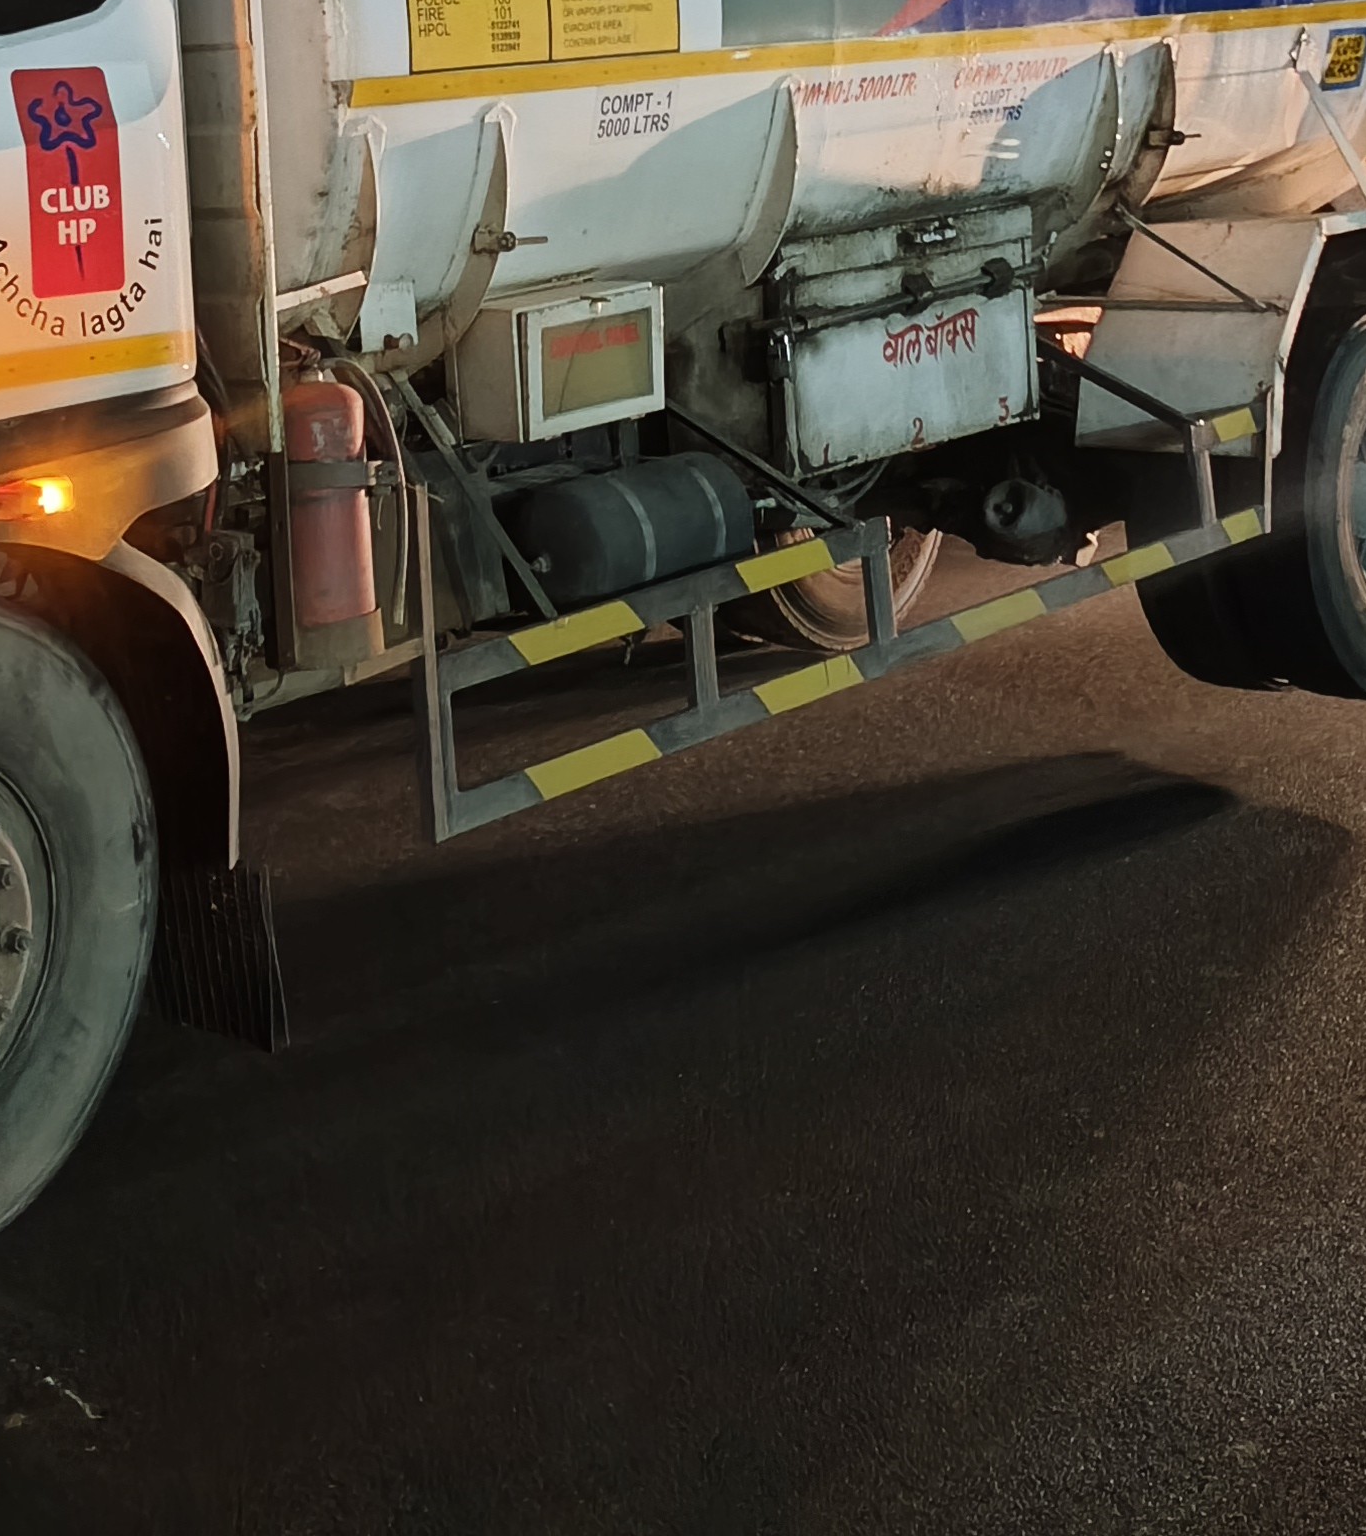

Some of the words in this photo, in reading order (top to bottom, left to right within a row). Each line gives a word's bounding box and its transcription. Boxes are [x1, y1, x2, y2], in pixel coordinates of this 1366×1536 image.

[417, 6, 446, 22] FIRE
[494, 6, 512, 20] 101
[418, 22, 451, 38] HPCL
[601, 92, 654, 115] COMPT
[666, 90, 672, 109] 1
[973, 88, 1012, 107] COMPT
[597, 117, 630, 139] 5000
[633, 112, 670, 135] LTRS
[995, 105, 1023, 122] LTRS
[40, 184, 110, 214] CLUB
[58, 218, 97, 245] HP
[80, 281, 147, 337] lagta
[138, 218, 163, 271] hai
[911, 417, 925, 445] 2
